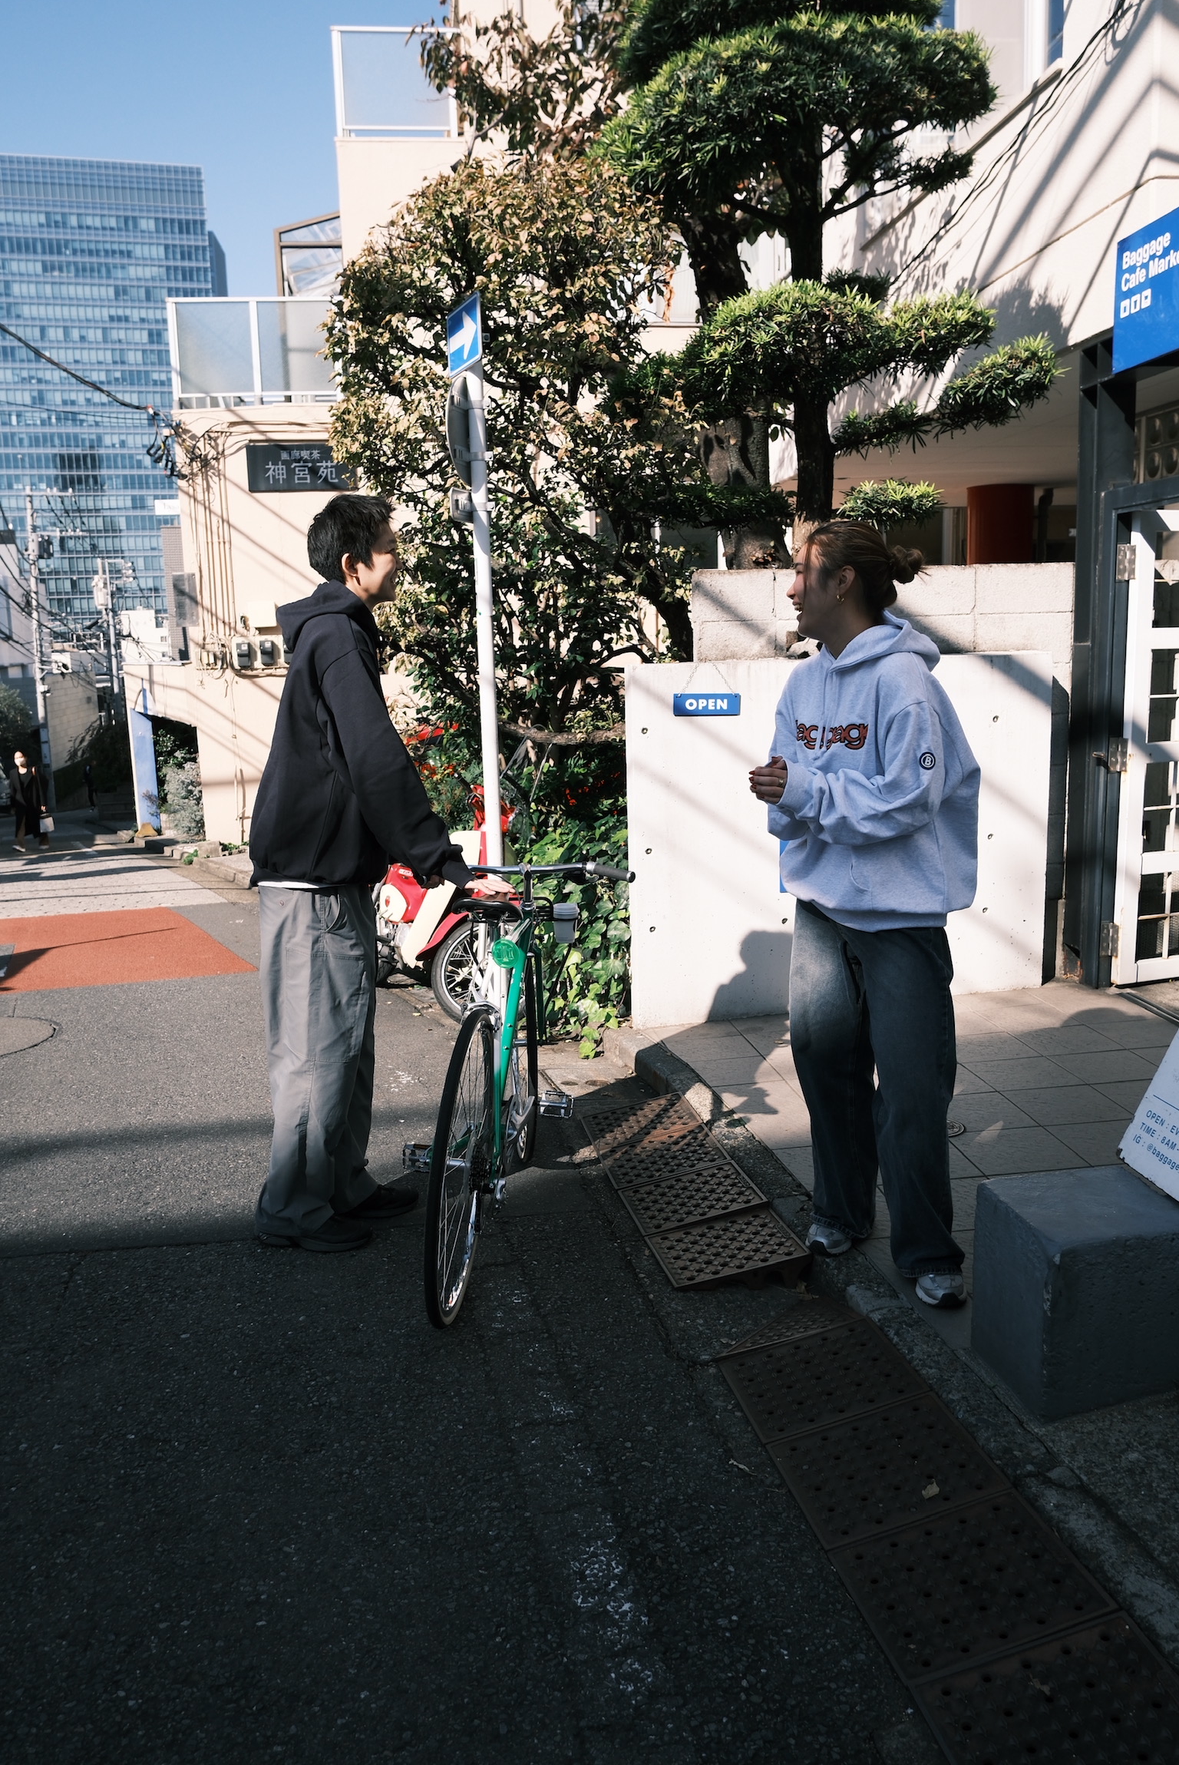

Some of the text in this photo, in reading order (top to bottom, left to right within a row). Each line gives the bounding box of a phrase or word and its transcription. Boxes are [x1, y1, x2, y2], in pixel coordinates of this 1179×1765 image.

[1122, 232, 1171, 270] Baggage
[1121, 266, 1147, 292] Cafe
[265, 460, 339, 484] 神宮苑
[685, 698, 728, 711] OPEN
[1146, 1110, 1166, 1127] OPEN
[1140, 1122, 1157, 1138] TIME
[1133, 1134, 1142, 1144] IG
